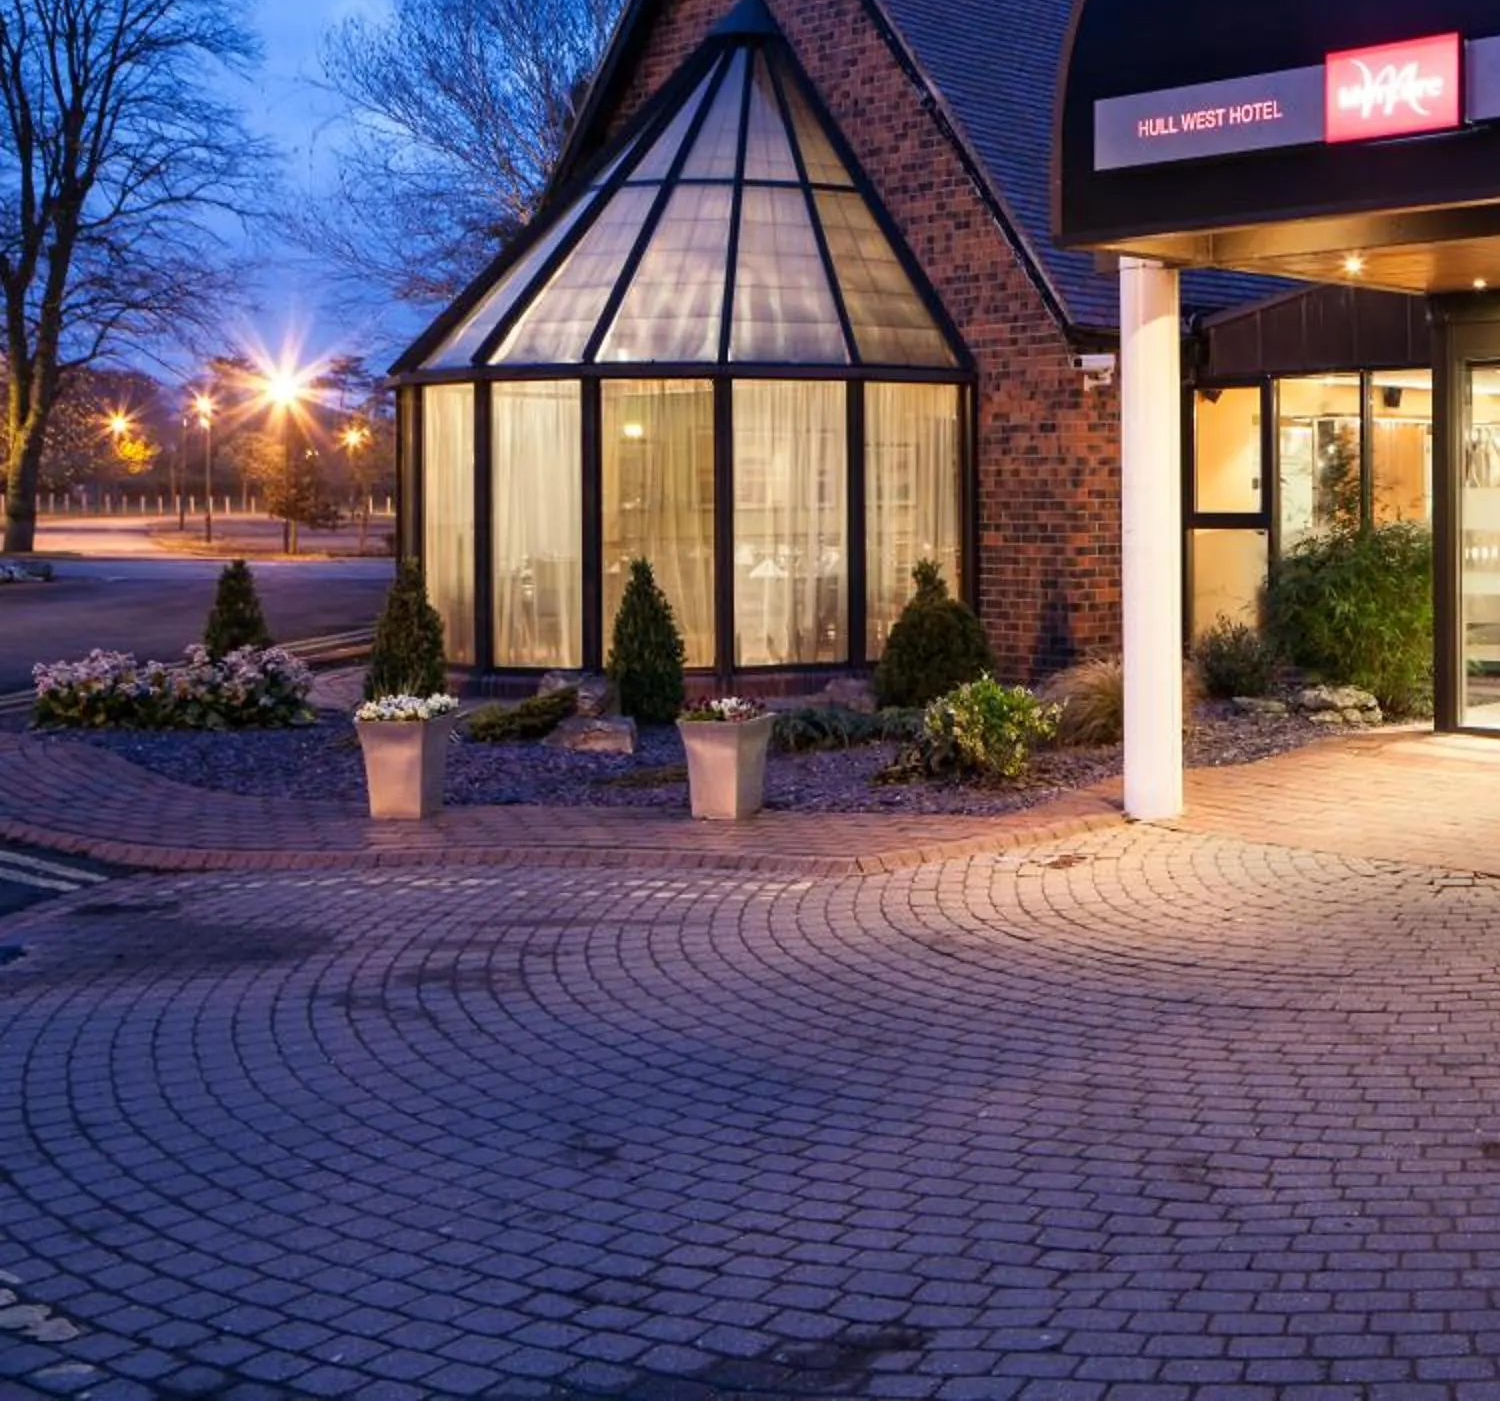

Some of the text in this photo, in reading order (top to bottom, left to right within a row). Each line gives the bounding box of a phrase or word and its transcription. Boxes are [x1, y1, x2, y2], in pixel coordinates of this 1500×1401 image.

[1138, 101, 1283, 137] HULL WEST HOTEL
